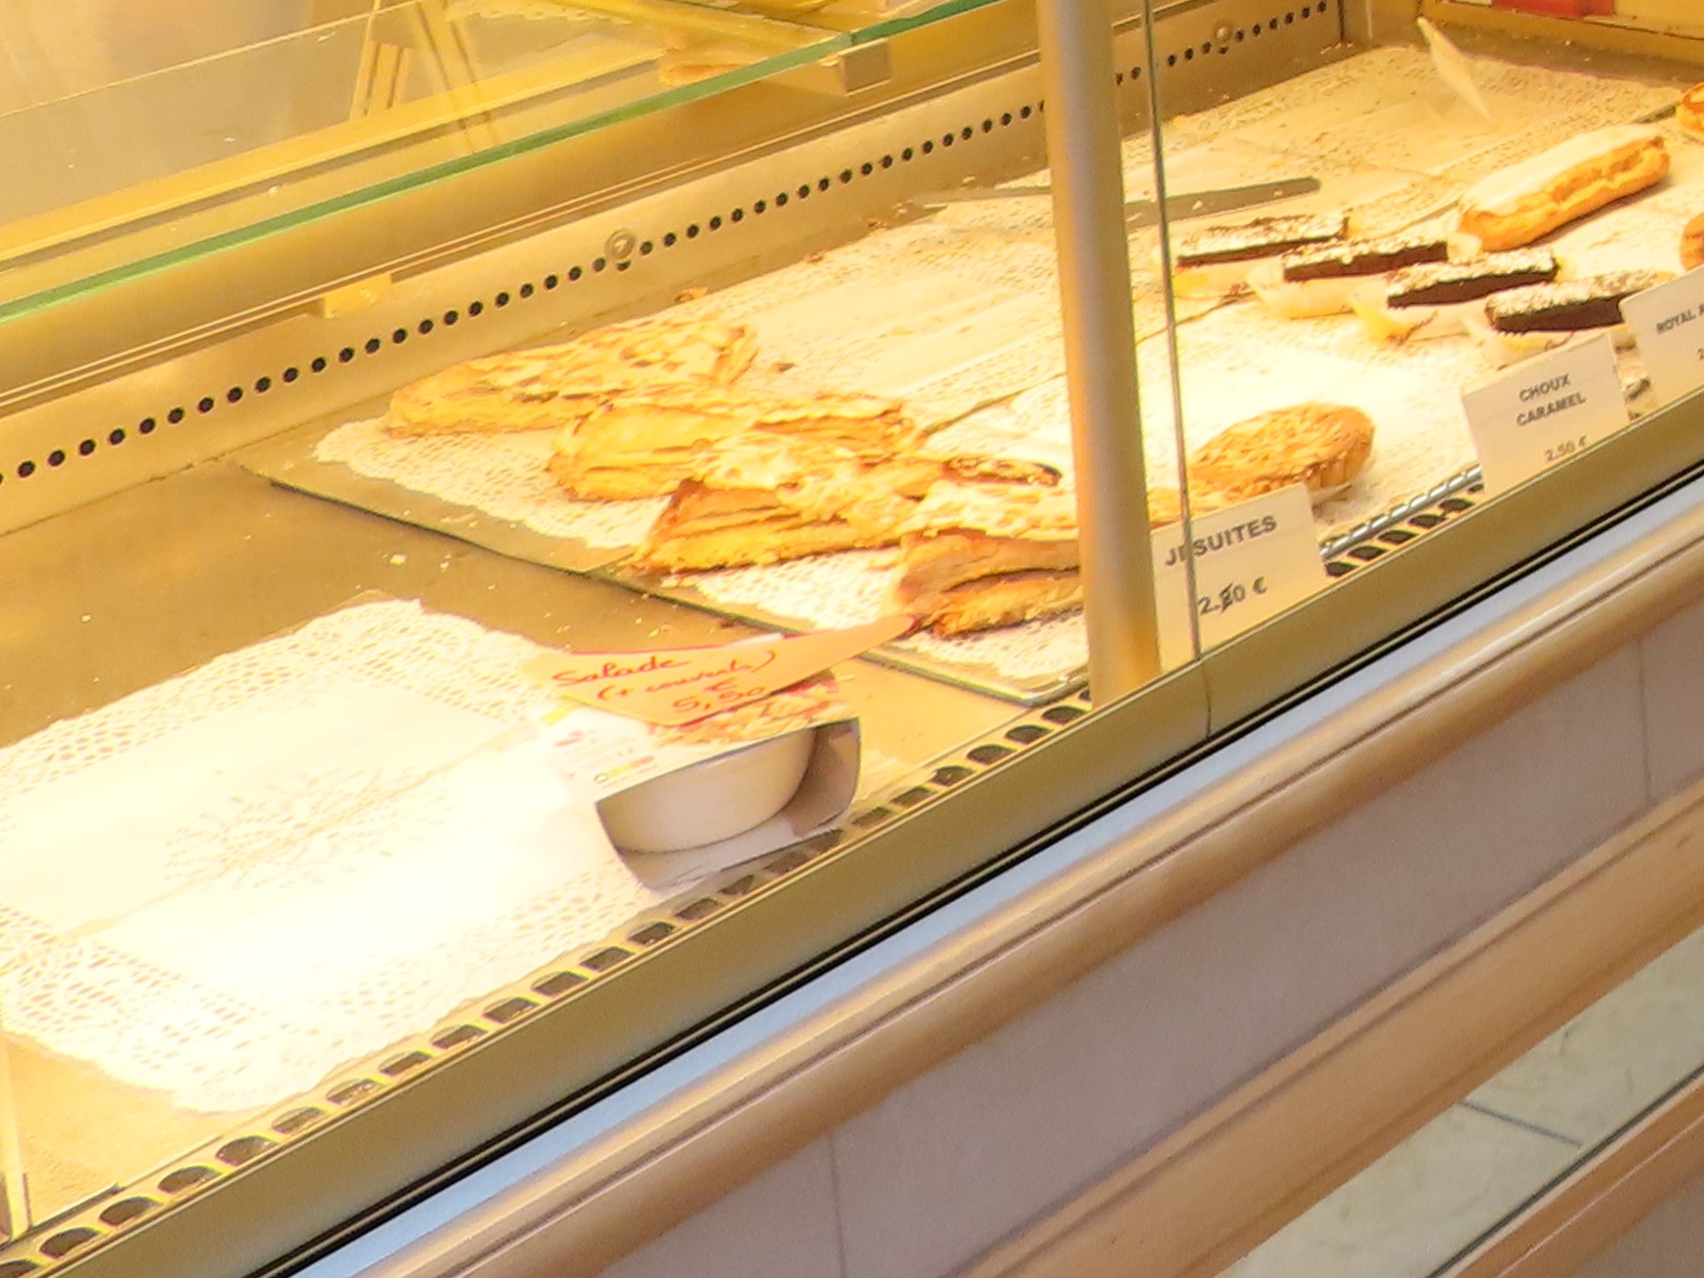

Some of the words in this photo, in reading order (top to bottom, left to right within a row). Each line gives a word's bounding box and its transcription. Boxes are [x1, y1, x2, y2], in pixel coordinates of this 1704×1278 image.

[1656, 309, 1696, 334] ROYAL
[1518, 373, 1571, 403] CHOUX
[1516, 392, 1587, 427] CARAMEL
[1578, 435, 1588, 448] €
[1252, 576, 1268, 595] €
[552, 655, 692, 687] Salade
